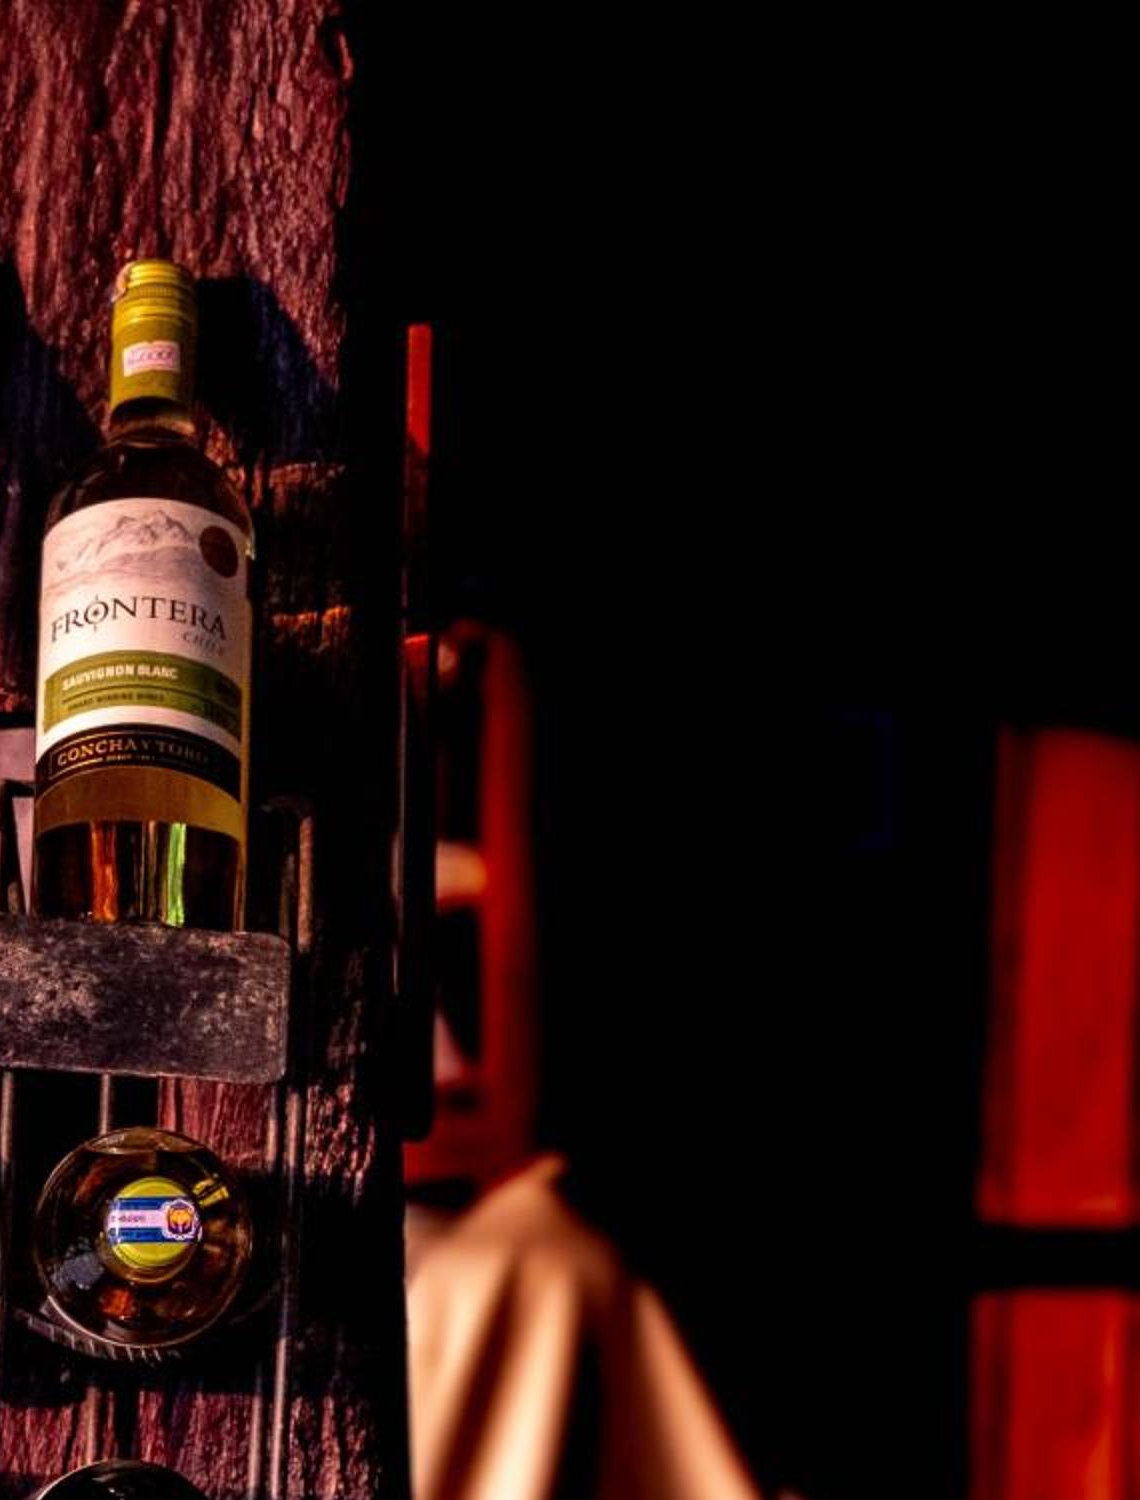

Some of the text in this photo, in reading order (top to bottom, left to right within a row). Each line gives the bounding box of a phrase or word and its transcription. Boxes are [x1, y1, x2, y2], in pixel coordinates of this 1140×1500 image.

[50, 596, 228, 643] FRONTERA
[62, 663, 179, 690] SAUVIGNON BLANC
[57, 738, 137, 766] CONCHA
